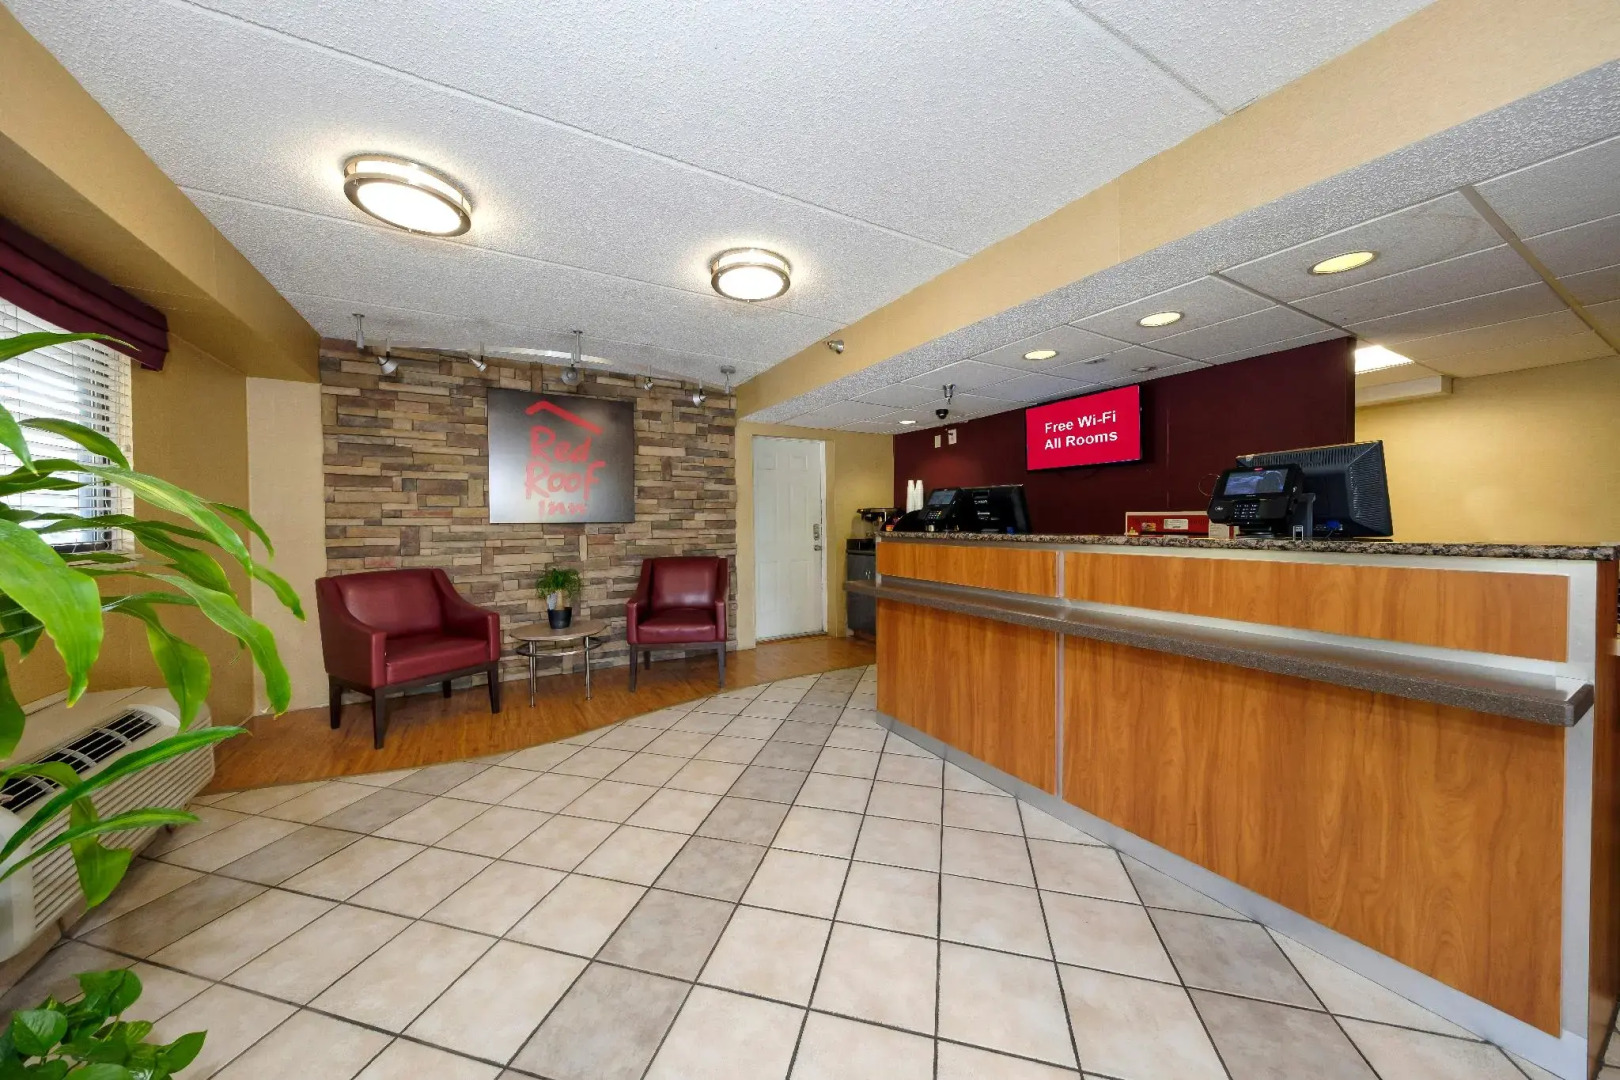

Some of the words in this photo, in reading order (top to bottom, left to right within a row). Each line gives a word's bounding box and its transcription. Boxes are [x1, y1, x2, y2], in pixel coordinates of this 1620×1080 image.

[1044, 420, 1074, 434] Free
[1077, 409, 1117, 428] Wi-Fi
[530, 425, 592, 463] Red
[1044, 437, 1062, 451] All
[1065, 430, 1119, 447] Rooms
[525, 460, 607, 501] Roof
